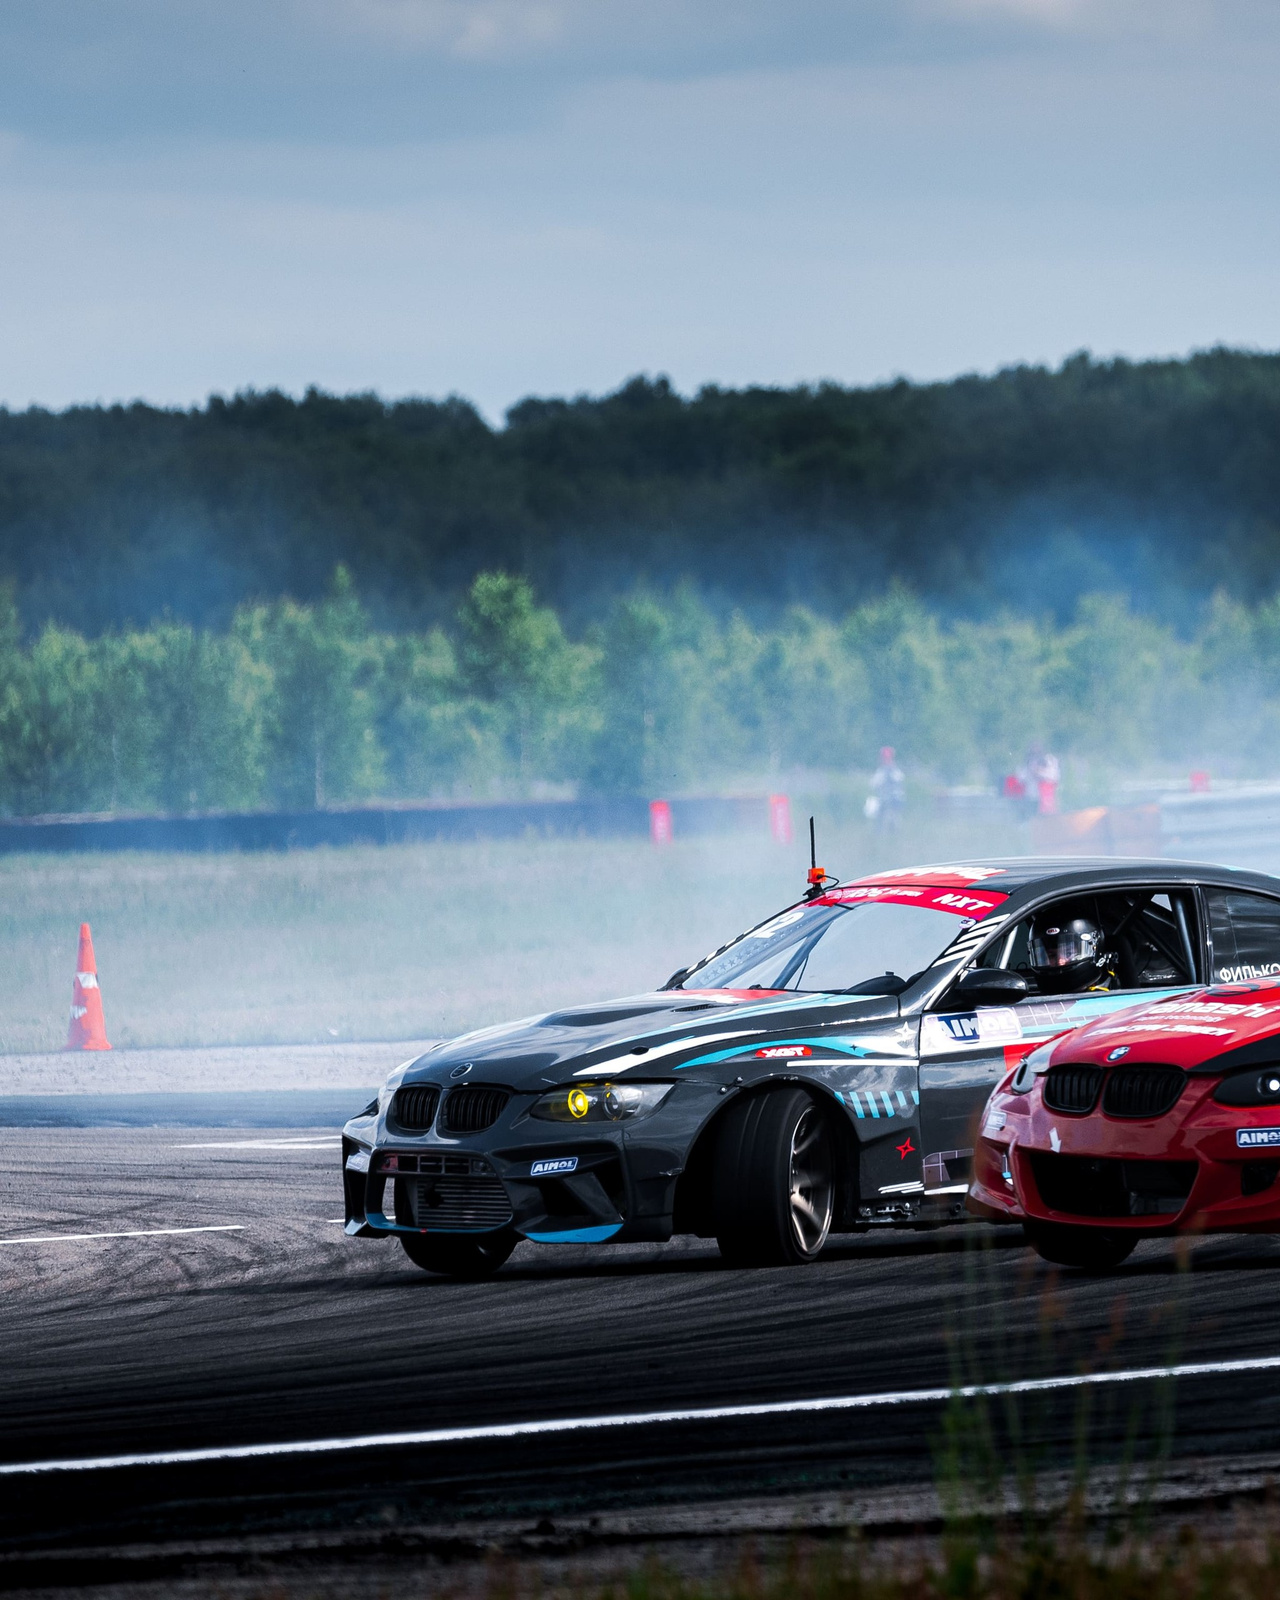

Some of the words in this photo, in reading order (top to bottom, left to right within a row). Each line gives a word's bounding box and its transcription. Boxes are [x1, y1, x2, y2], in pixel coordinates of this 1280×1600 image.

[931, 893, 995, 911] NXT
[938, 1015, 1018, 1038] AIMOL
[533, 1160, 574, 1173] AIMOL
